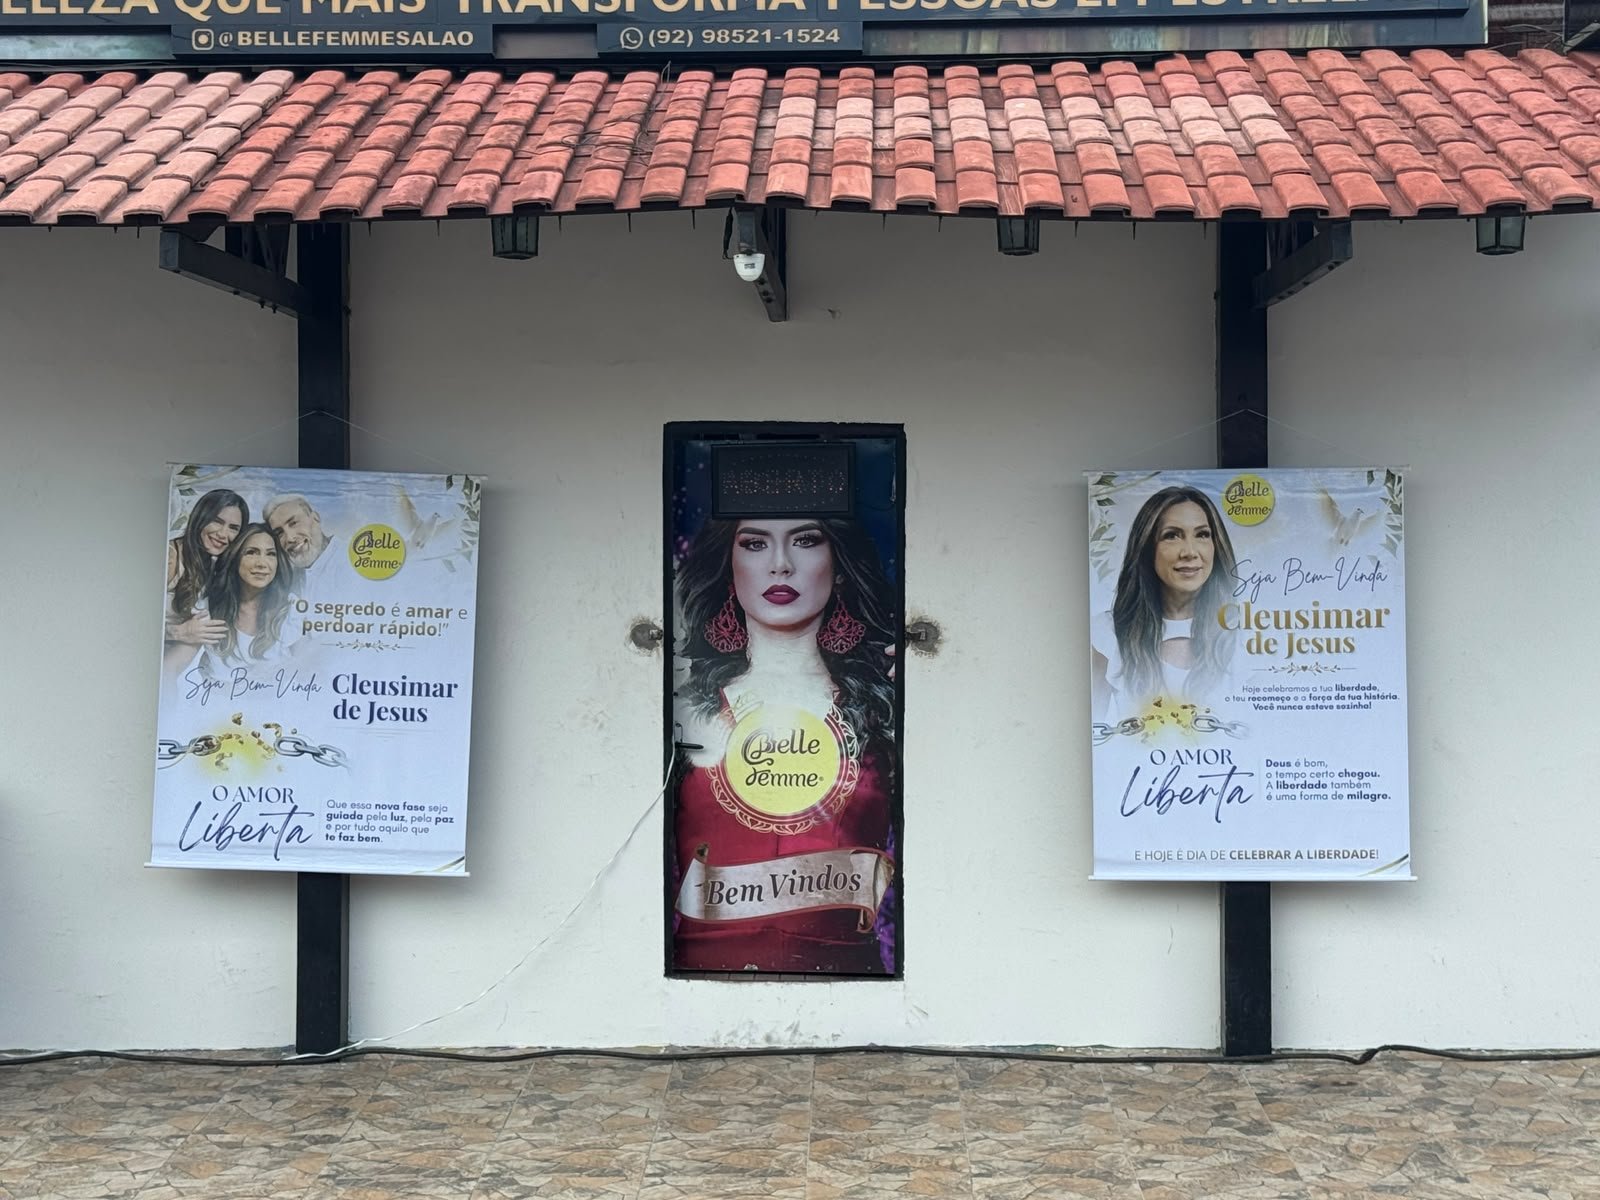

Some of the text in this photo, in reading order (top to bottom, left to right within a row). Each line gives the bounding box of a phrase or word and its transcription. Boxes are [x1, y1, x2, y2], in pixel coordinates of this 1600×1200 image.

[649, 28, 840, 47] (92) 98521-1524
[1230, 559, 1276, 604] Seja
[314, 602, 385, 618] segredo
[391, 603, 400, 617] é
[406, 606, 453, 619] amar
[458, 608, 468, 620] e
[1217, 600, 1390, 631] Cleusimar
[302, 618, 374, 636] perdoar
[1246, 631, 1356, 660] de Jesus
[185, 666, 224, 706] Seja
[332, 673, 458, 698] Cleusimar
[1242, 685, 1261, 694] Hoje
[1262, 684, 1310, 693] celebramos
[1335, 683, 1380, 692] liberdade,
[1248, 695, 1291, 703] recomeço
[1308, 693, 1332, 703] força
[1364, 692, 1400, 700] história.
[1336, 701, 1372, 710] sozinha!
[333, 698, 428, 725] de Jesus
[741, 728, 820, 766] Belle
[1150, 748, 1233, 766] O AMOR
[1266, 758, 1328, 768] Deus é bom,
[1275, 770, 1307, 780] tempo
[1309, 770, 1335, 779] certo
[1338, 768, 1380, 780] chegou.
[1266, 779, 1371, 790] A liberdade também
[212, 785, 294, 804] O AMOR
[1120, 765, 1254, 824] Liberta
[1266, 792, 1272, 801] é
[1300, 791, 1328, 800] forma
[1331, 790, 1344, 800] de
[1347, 790, 1392, 802] milagre.
[326, 799, 448, 815] Que essa nova fase seja
[326, 811, 454, 825] guiada pela luz, pela paz
[179, 801, 315, 862] Liberta
[325, 832, 383, 843] te faz bem.
[335, 823, 351, 832] por
[354, 823, 376, 832] tudo
[379, 823, 408, 834] aquilo
[411, 827, 430, 836] que
[1134, 848, 1379, 862] E HOJE É DIA DE CELEBRAR A LIBERDADE!
[706, 864, 862, 905] Bem Vindos
